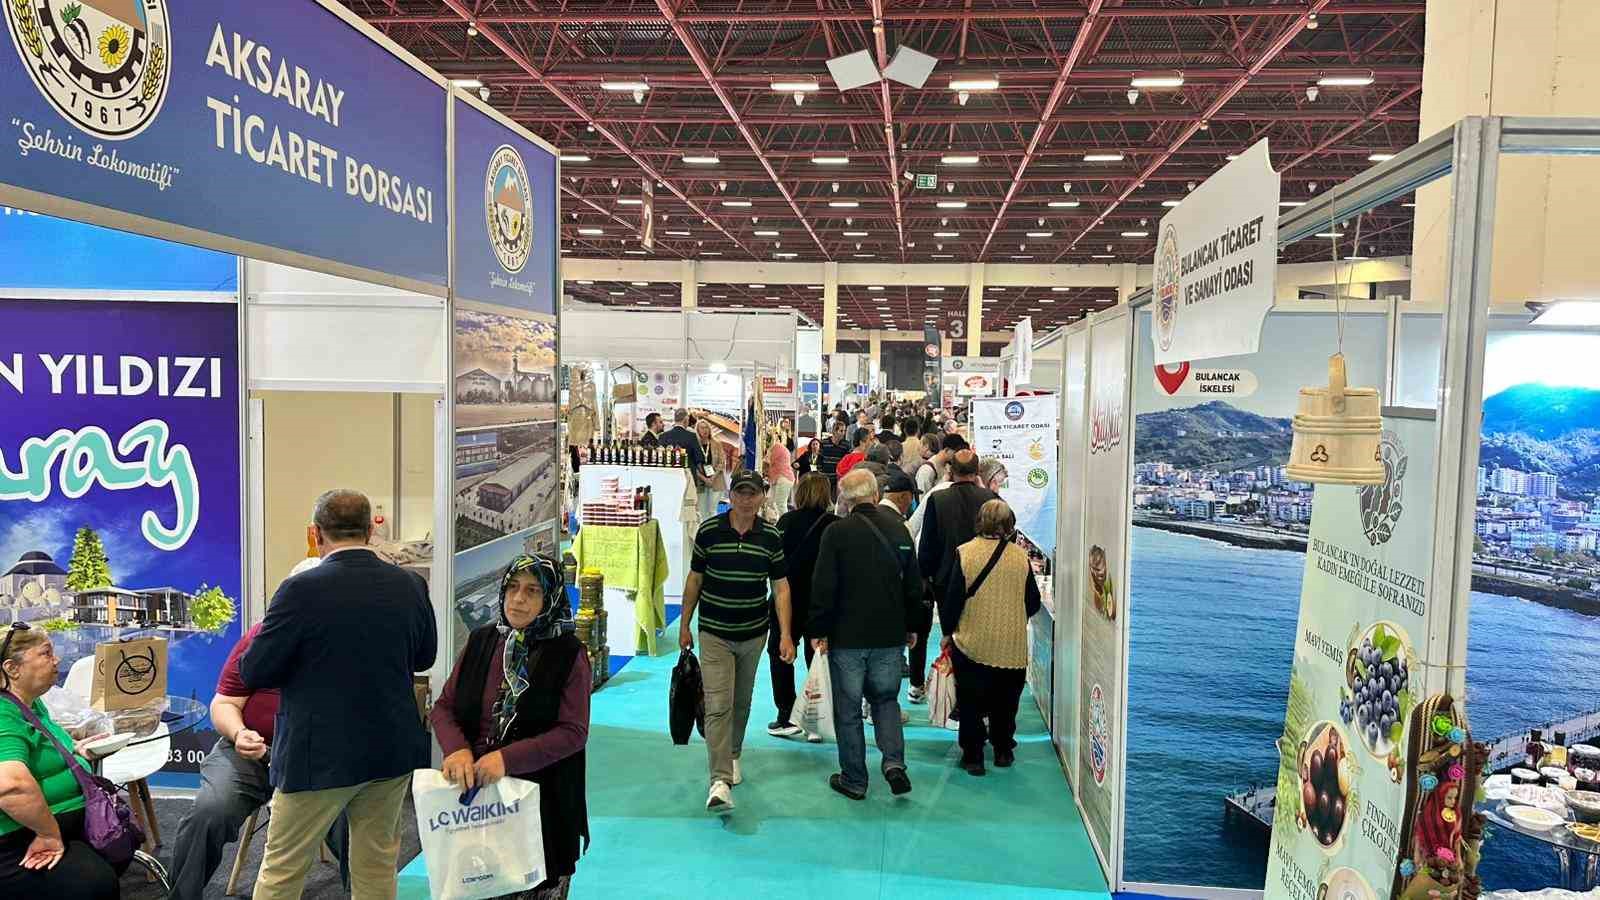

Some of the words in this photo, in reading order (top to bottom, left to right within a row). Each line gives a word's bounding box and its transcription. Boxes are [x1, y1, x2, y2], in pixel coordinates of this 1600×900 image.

[205, 22, 345, 127] AKSARAY
[70, 92, 123, 125] 1967
[206, 94, 338, 188] TİCARET
[345, 156, 433, 224] BORSASI
[1181, 238, 1219, 277] BULANCAK
[1220, 215, 1264, 258] TİCARET
[1184, 284, 1194, 306] VE
[1194, 266, 1222, 302] SANAYİ
[1224, 259, 1254, 292] ODASI
[950, 319, 964, 338] 3
[39, 354, 222, 398] YILDIZI
[1195, 372, 1241, 381] BULANCAK
[0, 418, 200, 551] ray
[1317, 556, 1338, 577] KADIN
[1361, 557, 1388, 581] DOĞAL
[187, 750, 205, 764] 00
[429, 811, 450, 831] LC
